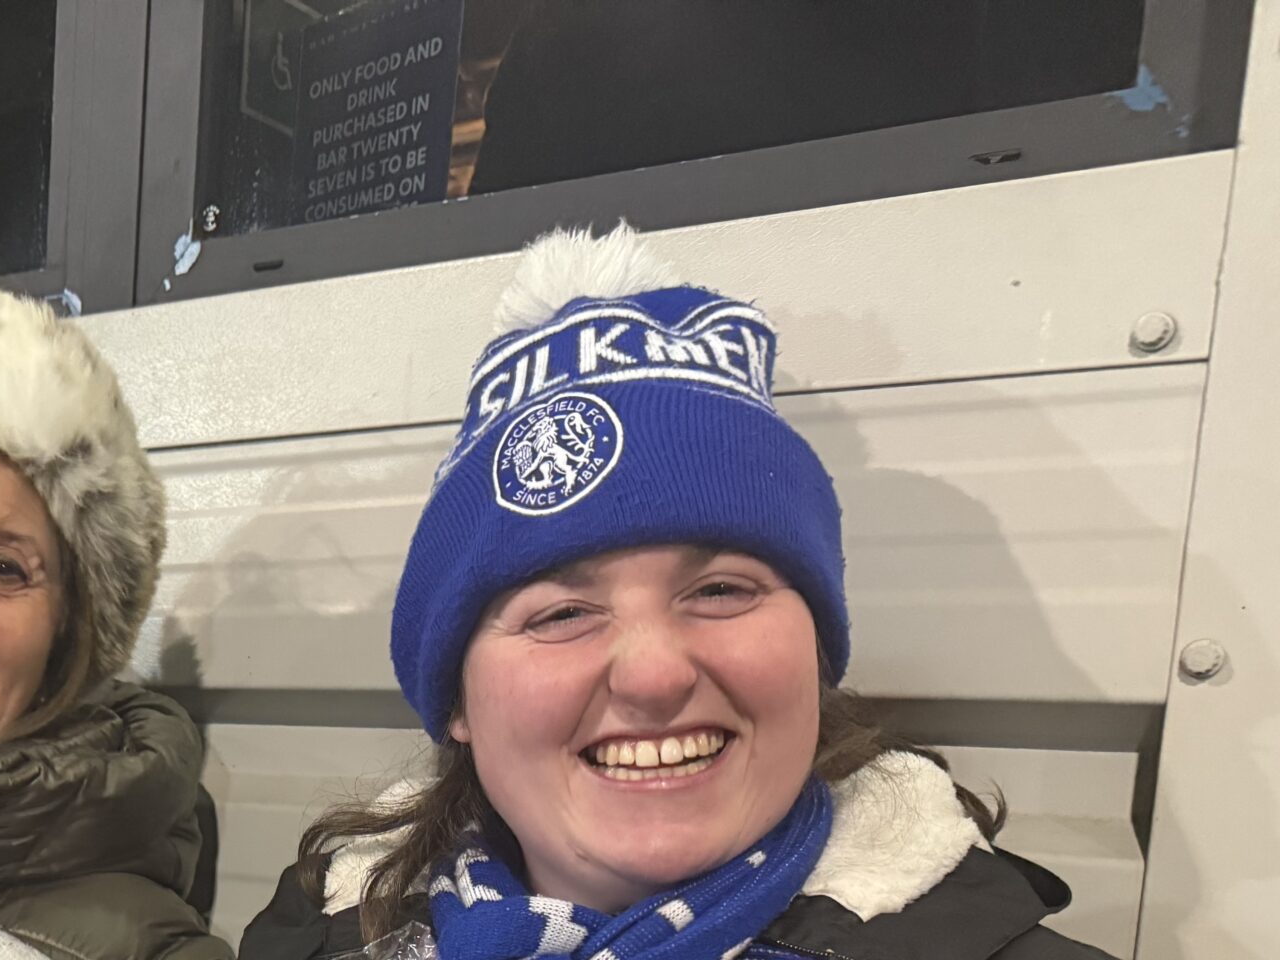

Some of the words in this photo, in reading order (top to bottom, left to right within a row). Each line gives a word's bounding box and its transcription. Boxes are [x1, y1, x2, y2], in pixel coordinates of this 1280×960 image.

[308, 68, 352, 100] ONLY
[354, 51, 401, 84] FOOD
[403, 36, 443, 67] AND
[313, 102, 407, 147] PURCHASED
[411, 93, 431, 116] IN
[346, 77, 398, 112] DRINK
[316, 147, 348, 171] BAR
[351, 120, 423, 160] TWENTY
[304, 185, 394, 222] CONSUMED
[398, 173, 427, 197] ON
[307, 167, 358, 199] SEVEN
[361, 162, 376, 183] IS
[379, 154, 401, 176] TO
[405, 146, 428, 169] BE
[501, 401, 587, 470] MACCLESFIELD
[585, 407, 605, 427] FC
[512, 488, 557, 505] SINCE
[577, 456, 605, 487] 1874
